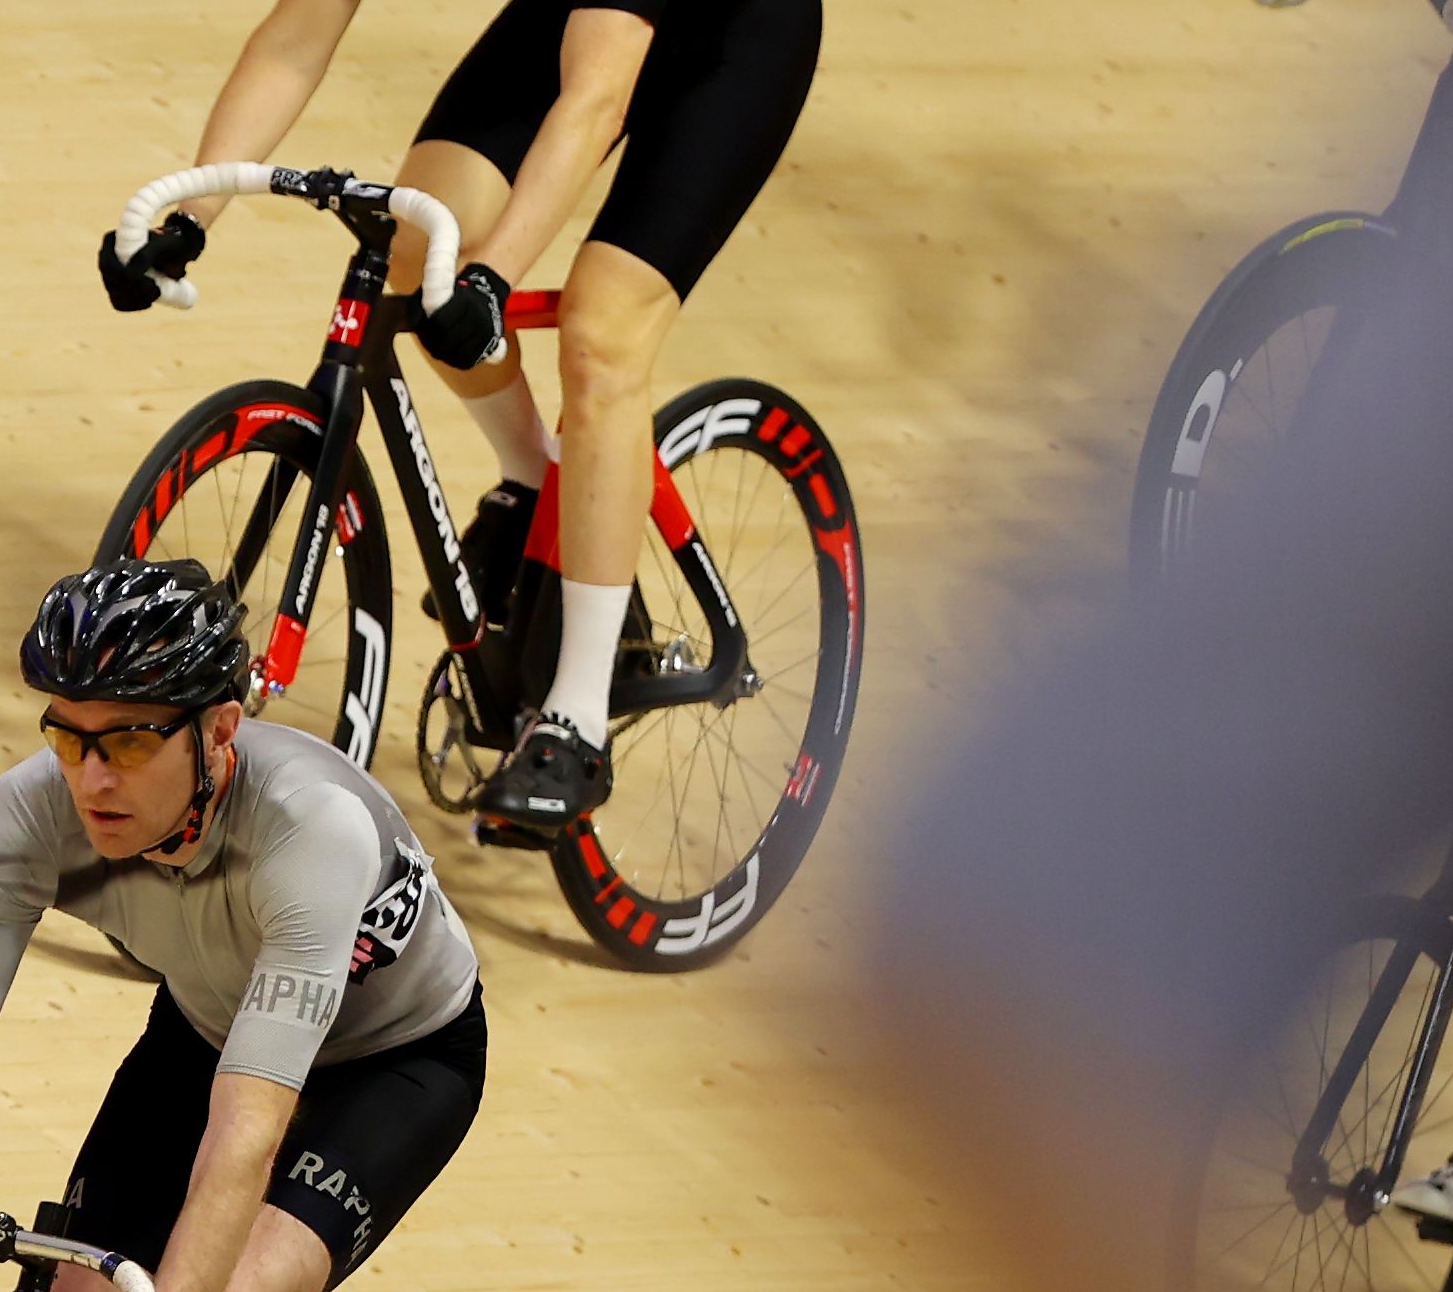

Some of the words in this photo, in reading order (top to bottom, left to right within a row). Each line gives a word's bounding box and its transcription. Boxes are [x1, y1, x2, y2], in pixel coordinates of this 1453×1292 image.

[295, 532, 324, 615] ARGON
[389, 376, 460, 564] ARGON
[451, 558, 480, 623] 18
